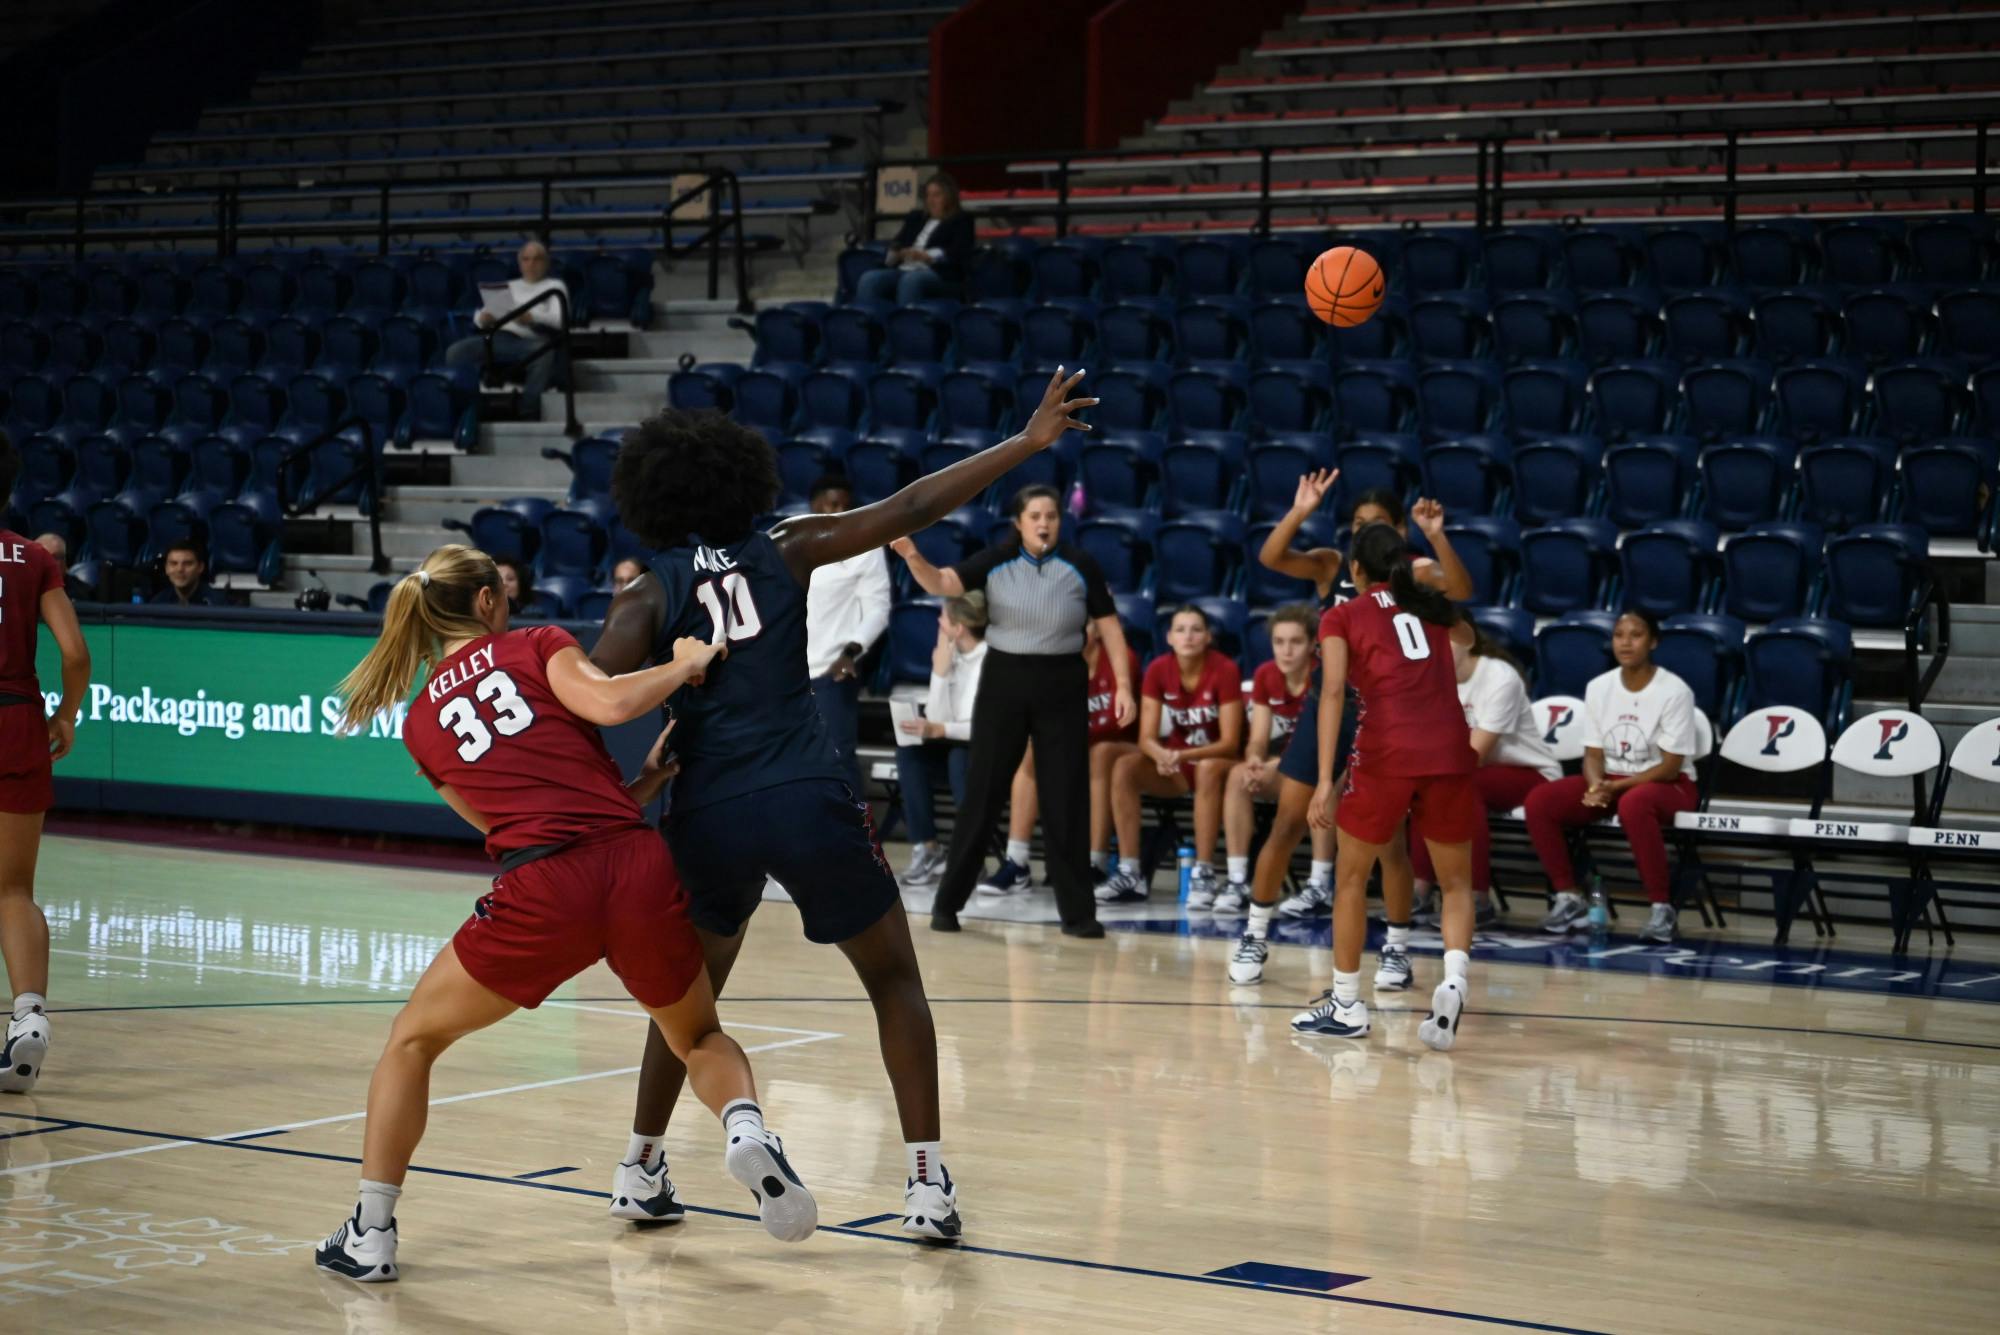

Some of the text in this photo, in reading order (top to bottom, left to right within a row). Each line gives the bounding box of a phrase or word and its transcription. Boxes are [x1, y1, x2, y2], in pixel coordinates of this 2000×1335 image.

[695, 572, 763, 646] 10
[1392, 612, 1431, 660] 0
[428, 643, 496, 703] KELLEY
[89, 684, 245, 738] Packaging
[253, 695, 312, 734] and
[437, 669, 535, 764] 33
[1761, 715, 1795, 756] P
[1873, 719, 1908, 760] P
[1698, 816, 1741, 830] PENN
[1815, 823, 1859, 837] PENN
[1934, 831, 1981, 846] PENN
